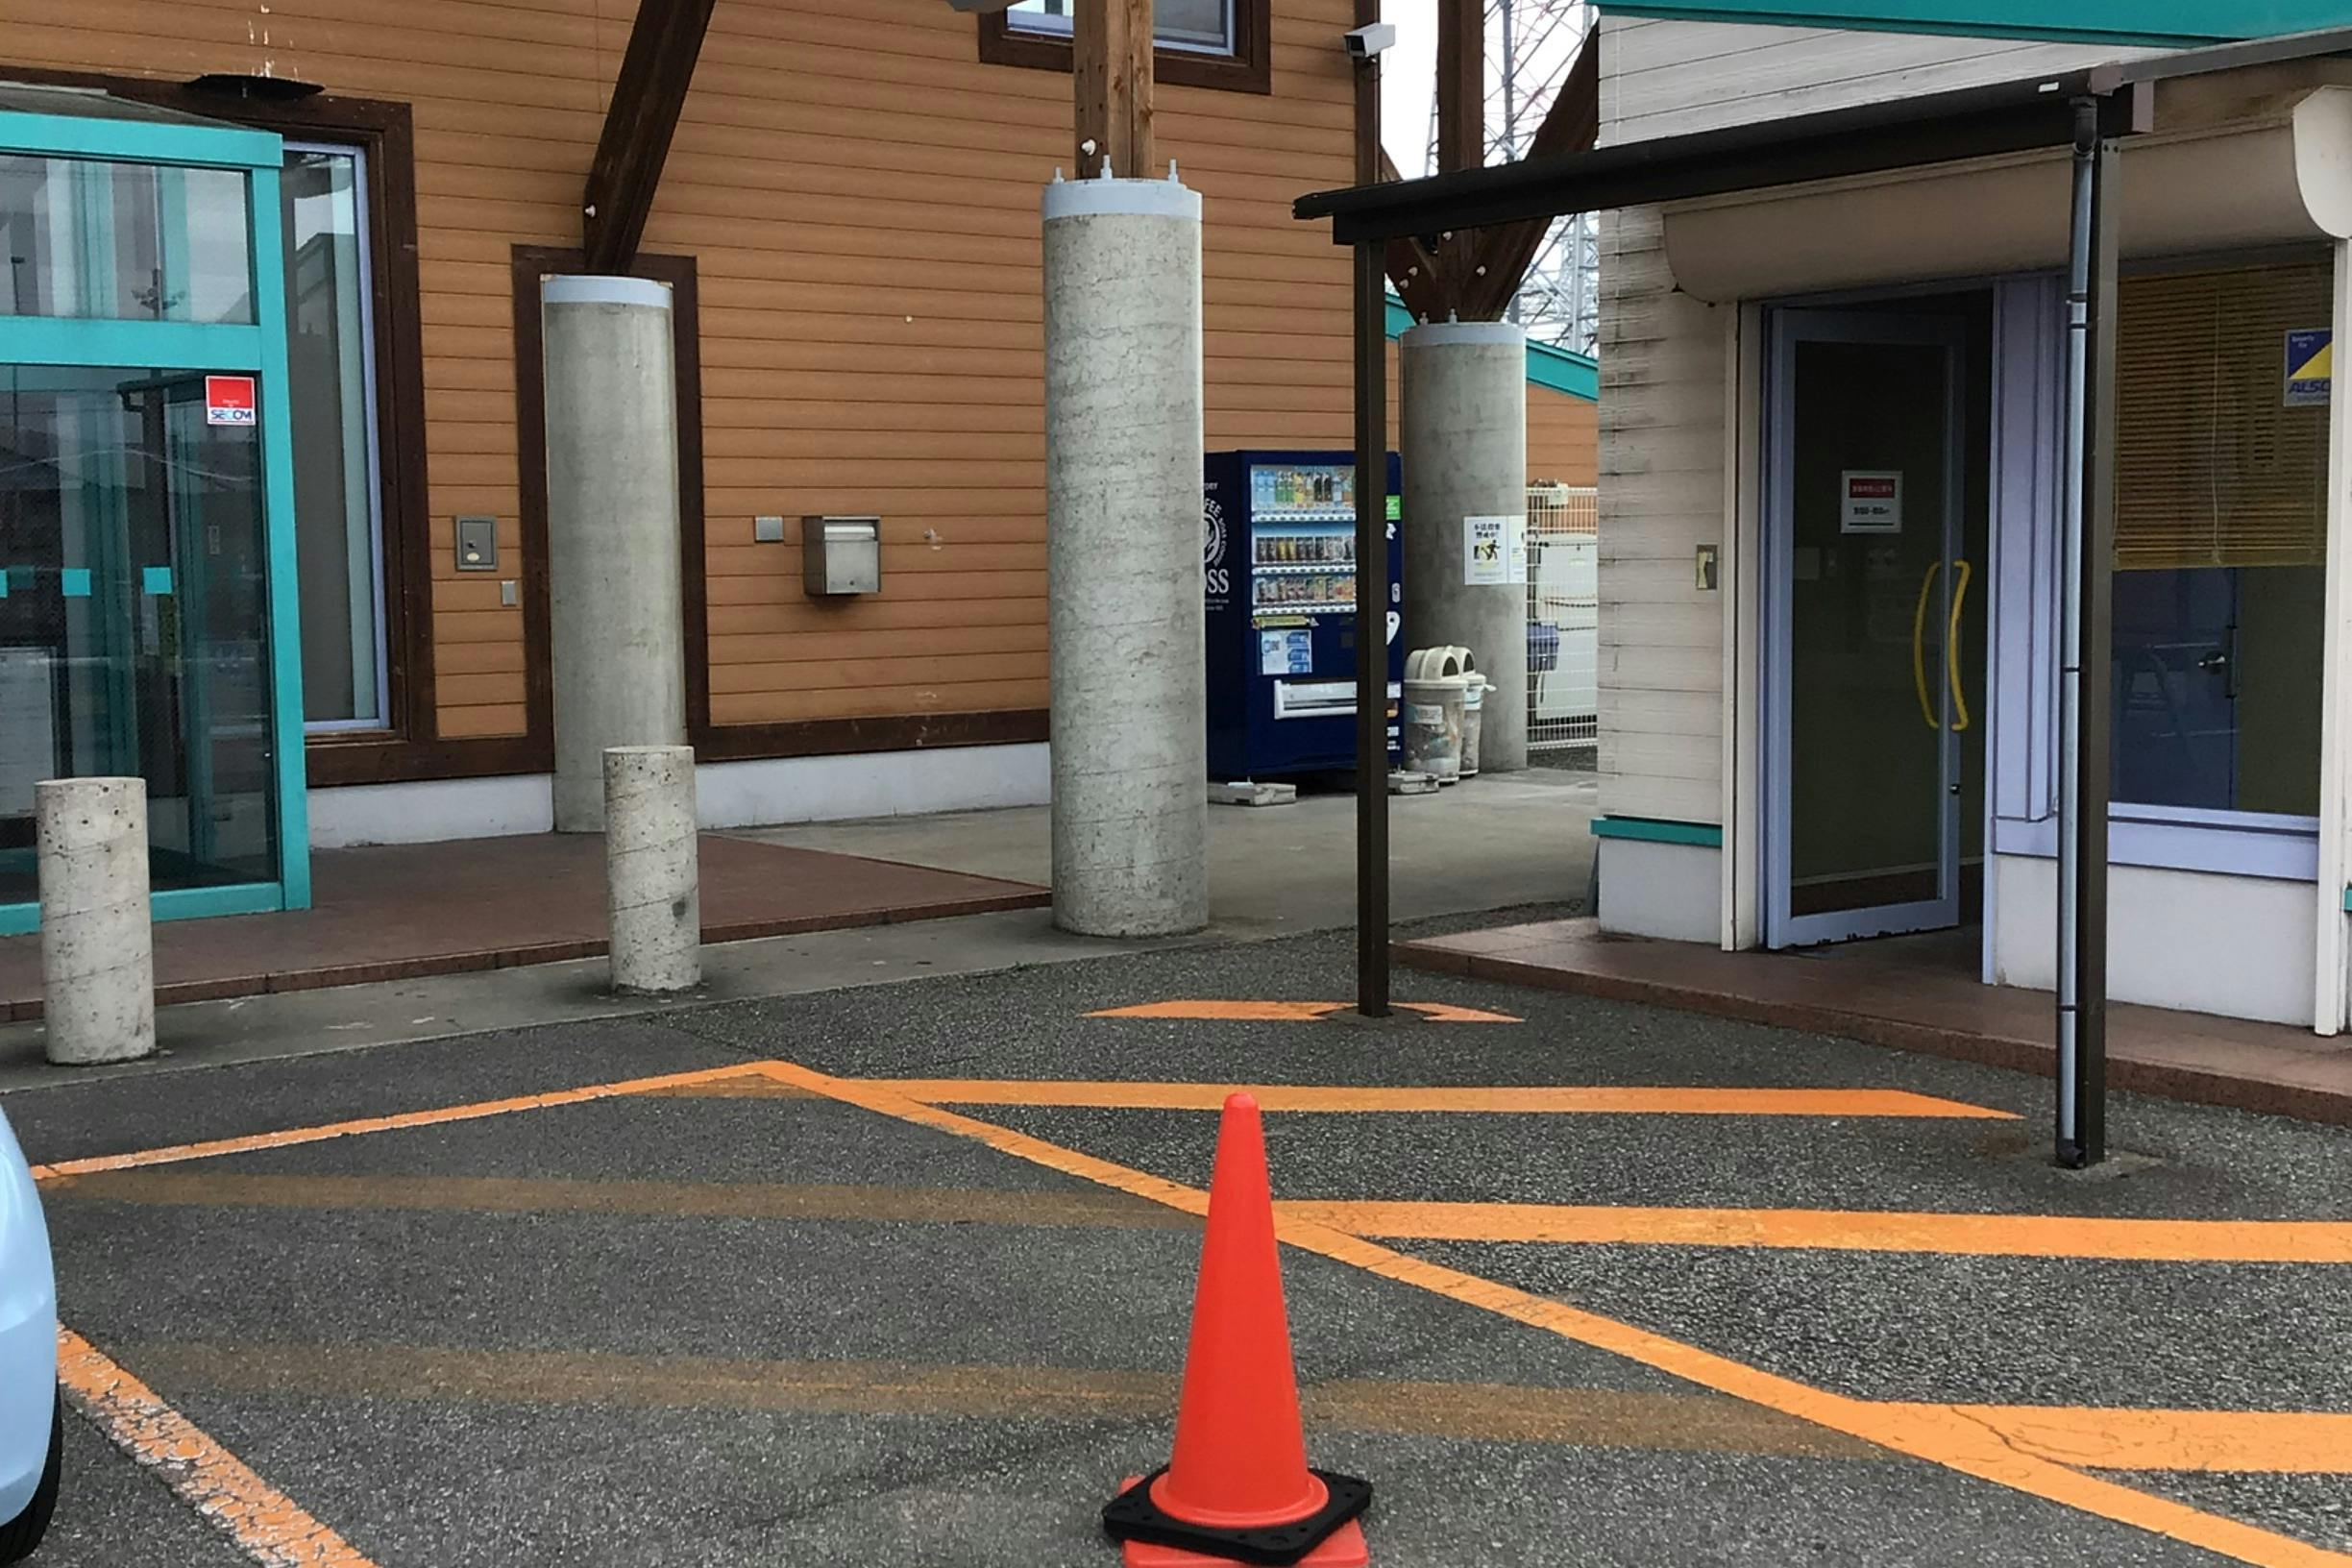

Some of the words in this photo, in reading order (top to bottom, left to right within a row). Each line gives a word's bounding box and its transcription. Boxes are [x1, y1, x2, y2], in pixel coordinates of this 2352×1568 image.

[2289, 380, 2330, 393] ALSO
[210, 409, 252, 420] SECOM
[1205, 498, 1222, 518] FEE
